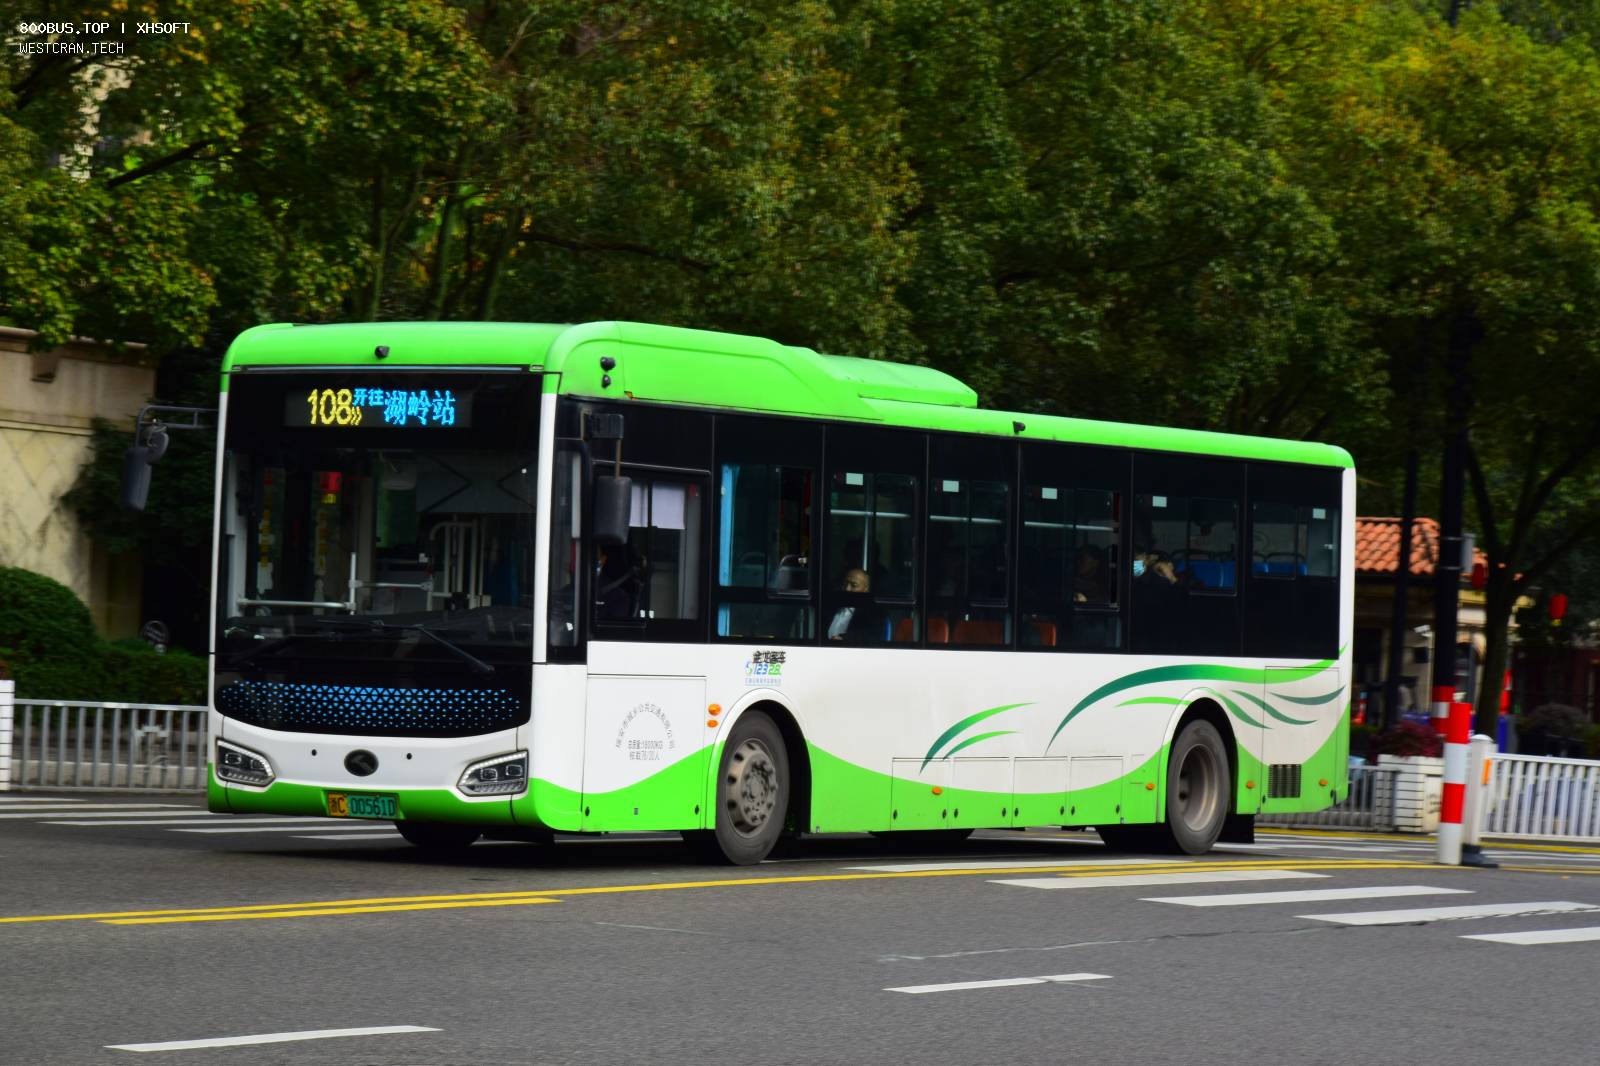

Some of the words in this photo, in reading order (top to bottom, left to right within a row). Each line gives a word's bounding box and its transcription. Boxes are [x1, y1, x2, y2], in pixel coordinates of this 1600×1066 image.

[307, 388, 352, 425] 108
[352, 387, 385, 407] 开往
[384, 389, 456, 426] 湖岭站
